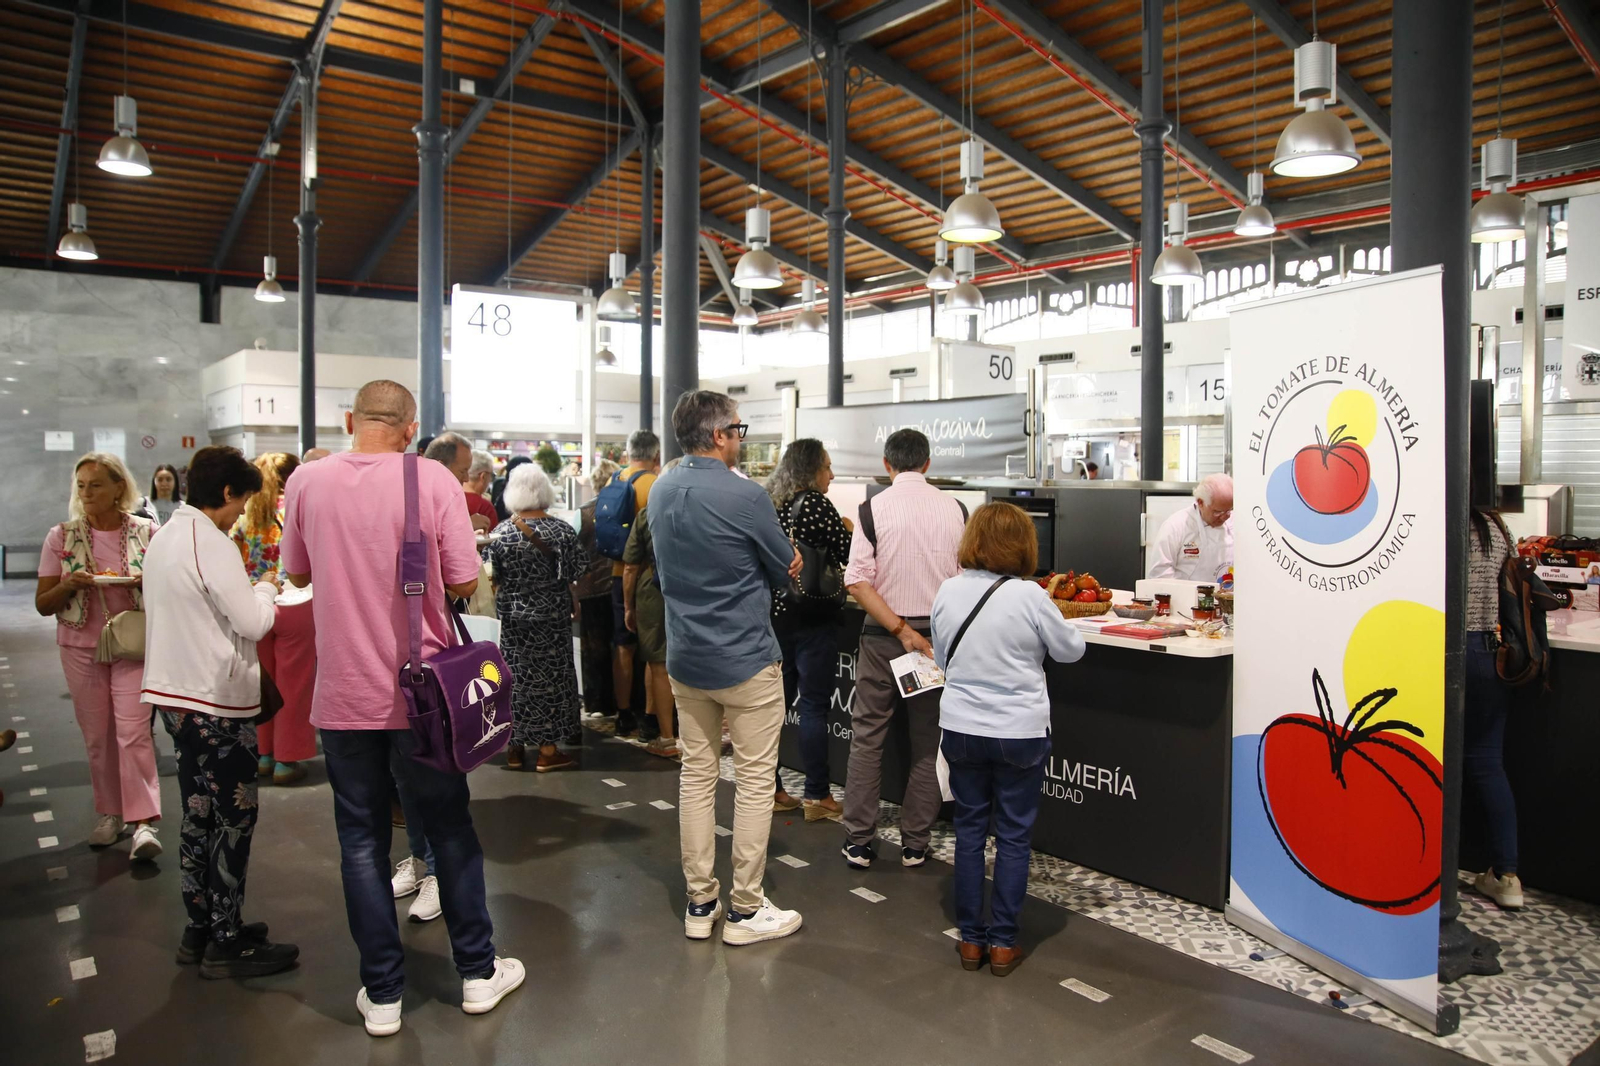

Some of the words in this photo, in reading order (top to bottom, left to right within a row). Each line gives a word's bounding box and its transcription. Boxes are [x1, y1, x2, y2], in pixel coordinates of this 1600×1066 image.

[467, 302, 512, 336] 48
[989, 354, 1013, 381] 50
[1199, 378, 1225, 402] 15
[254, 397, 274, 414] 11
[1249, 429, 1265, 453] EL
[1258, 358, 1320, 421] TOMATE
[1325, 355, 1350, 374] DE
[1354, 362, 1419, 452] ALMERÍA
[1251, 505, 1302, 582] COFRADÍA
[1308, 512, 1416, 592] GASTRONÓMICA
[1041, 781, 1084, 804] IUDAD
